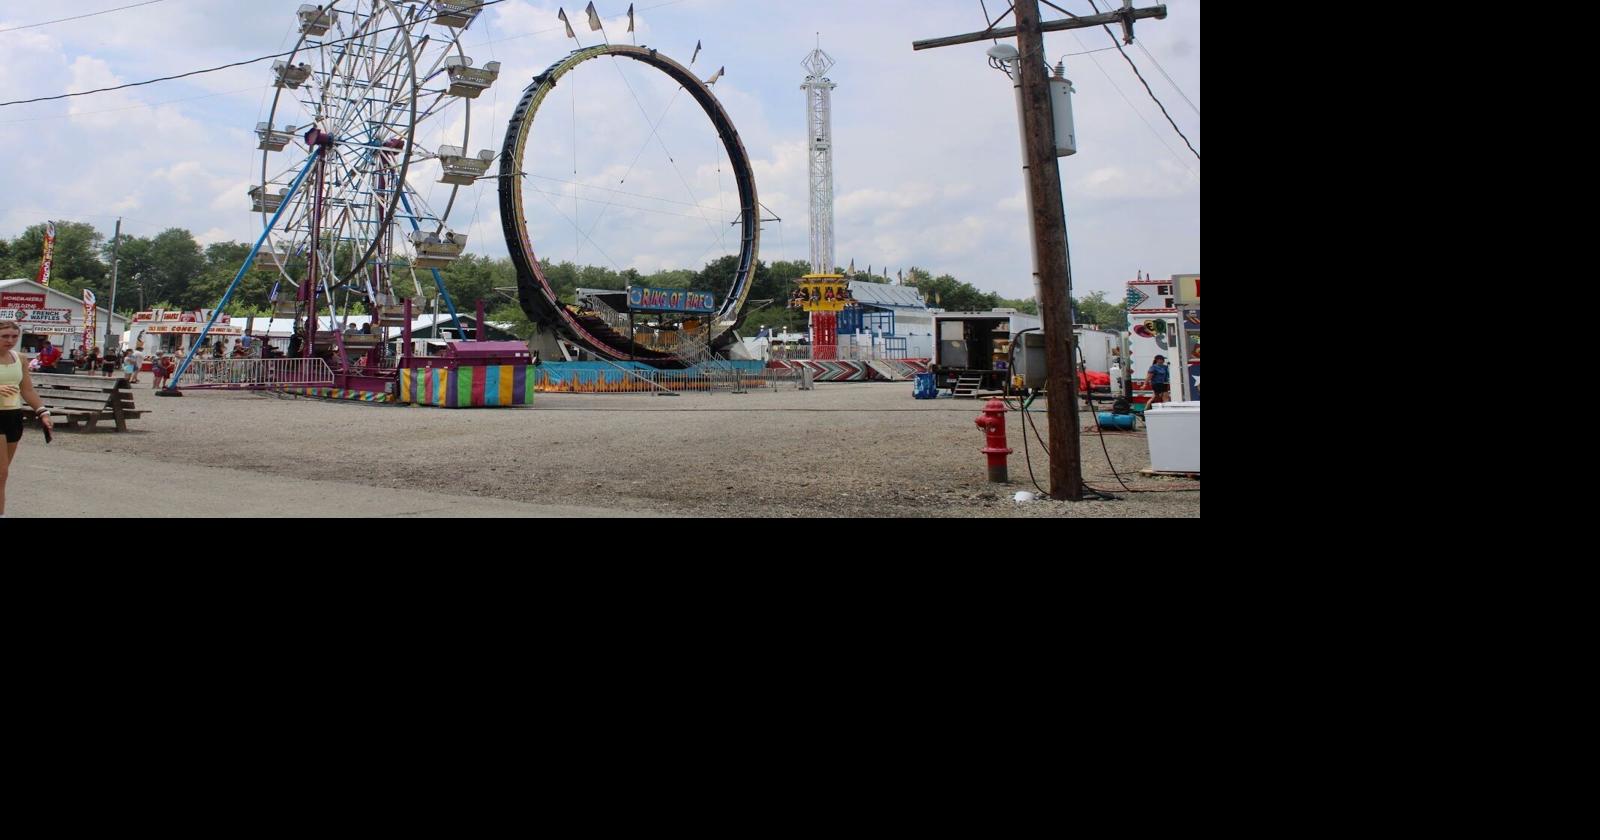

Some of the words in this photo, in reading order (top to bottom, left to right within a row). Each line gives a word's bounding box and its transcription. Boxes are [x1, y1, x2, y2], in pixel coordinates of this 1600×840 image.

[642, 288, 667, 306] RING
[670, 291, 684, 307] OF
[685, 291, 704, 308] FIRE
